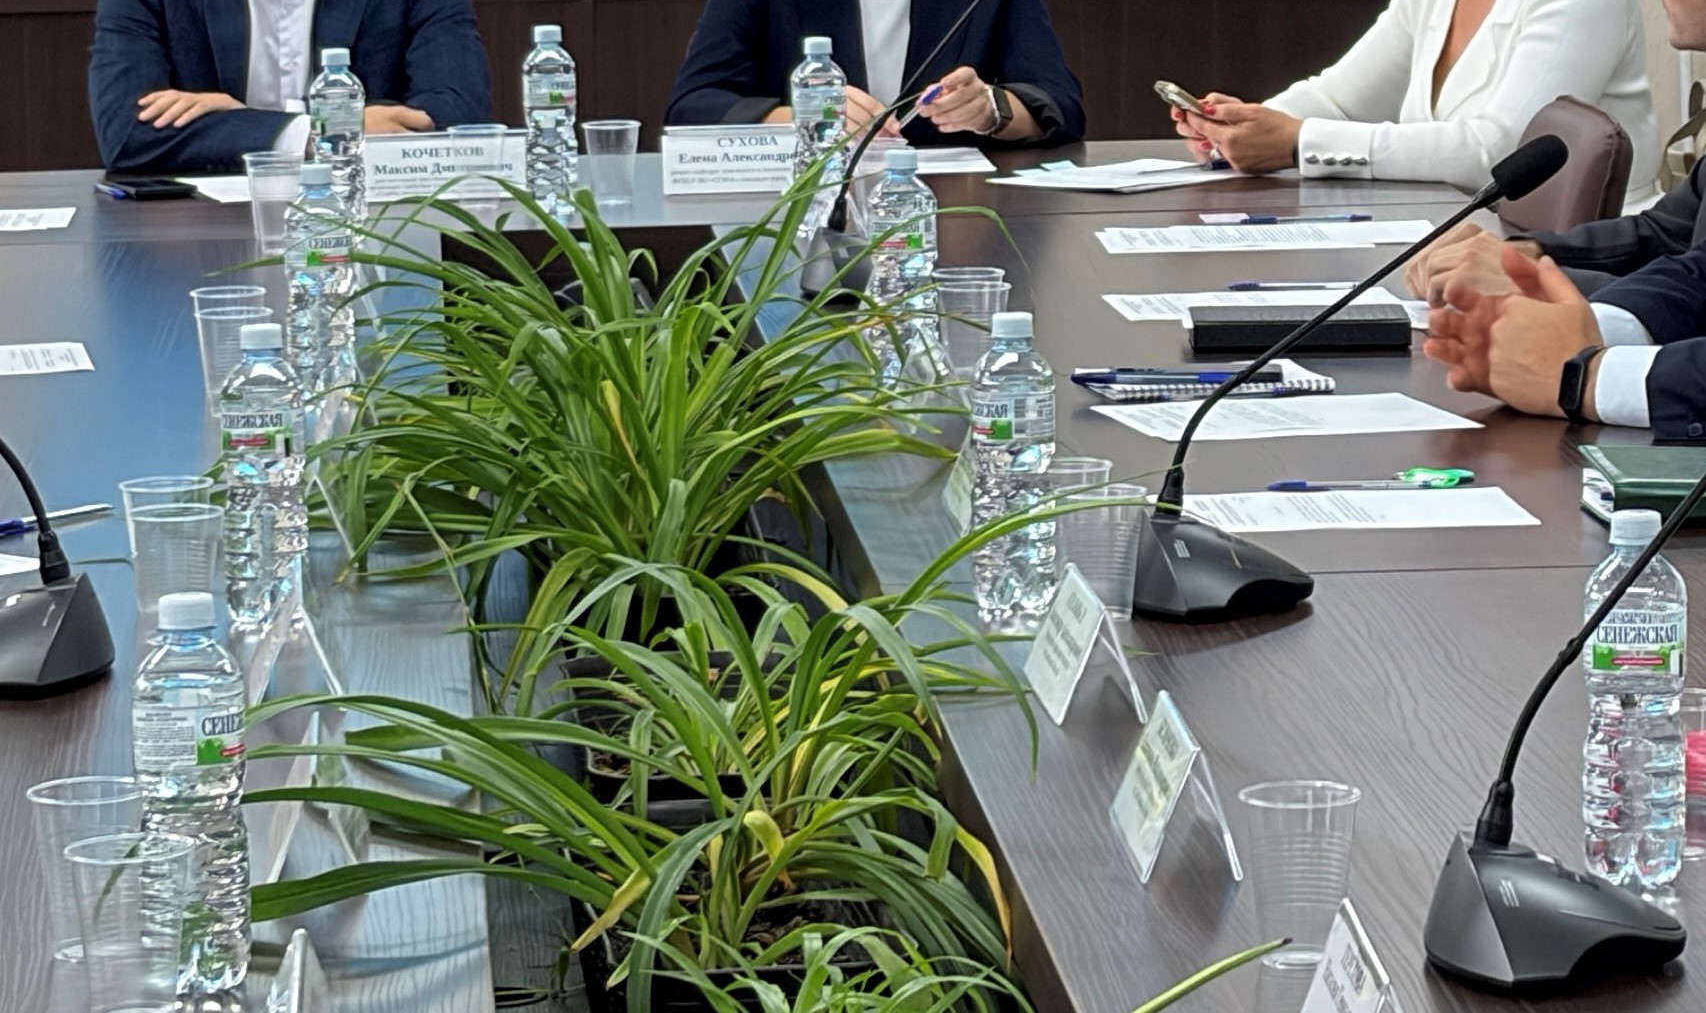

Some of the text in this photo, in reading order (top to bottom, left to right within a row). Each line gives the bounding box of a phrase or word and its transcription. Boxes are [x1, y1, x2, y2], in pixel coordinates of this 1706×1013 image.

[717, 134, 779, 149] СУХОВА
[401, 146, 484, 160] КОЧЕТКОВ
[678, 151, 717, 165] Елена
[374, 164, 428, 176] Максим
[1596, 624, 1678, 645] СЕНЕЖСКАЯ
